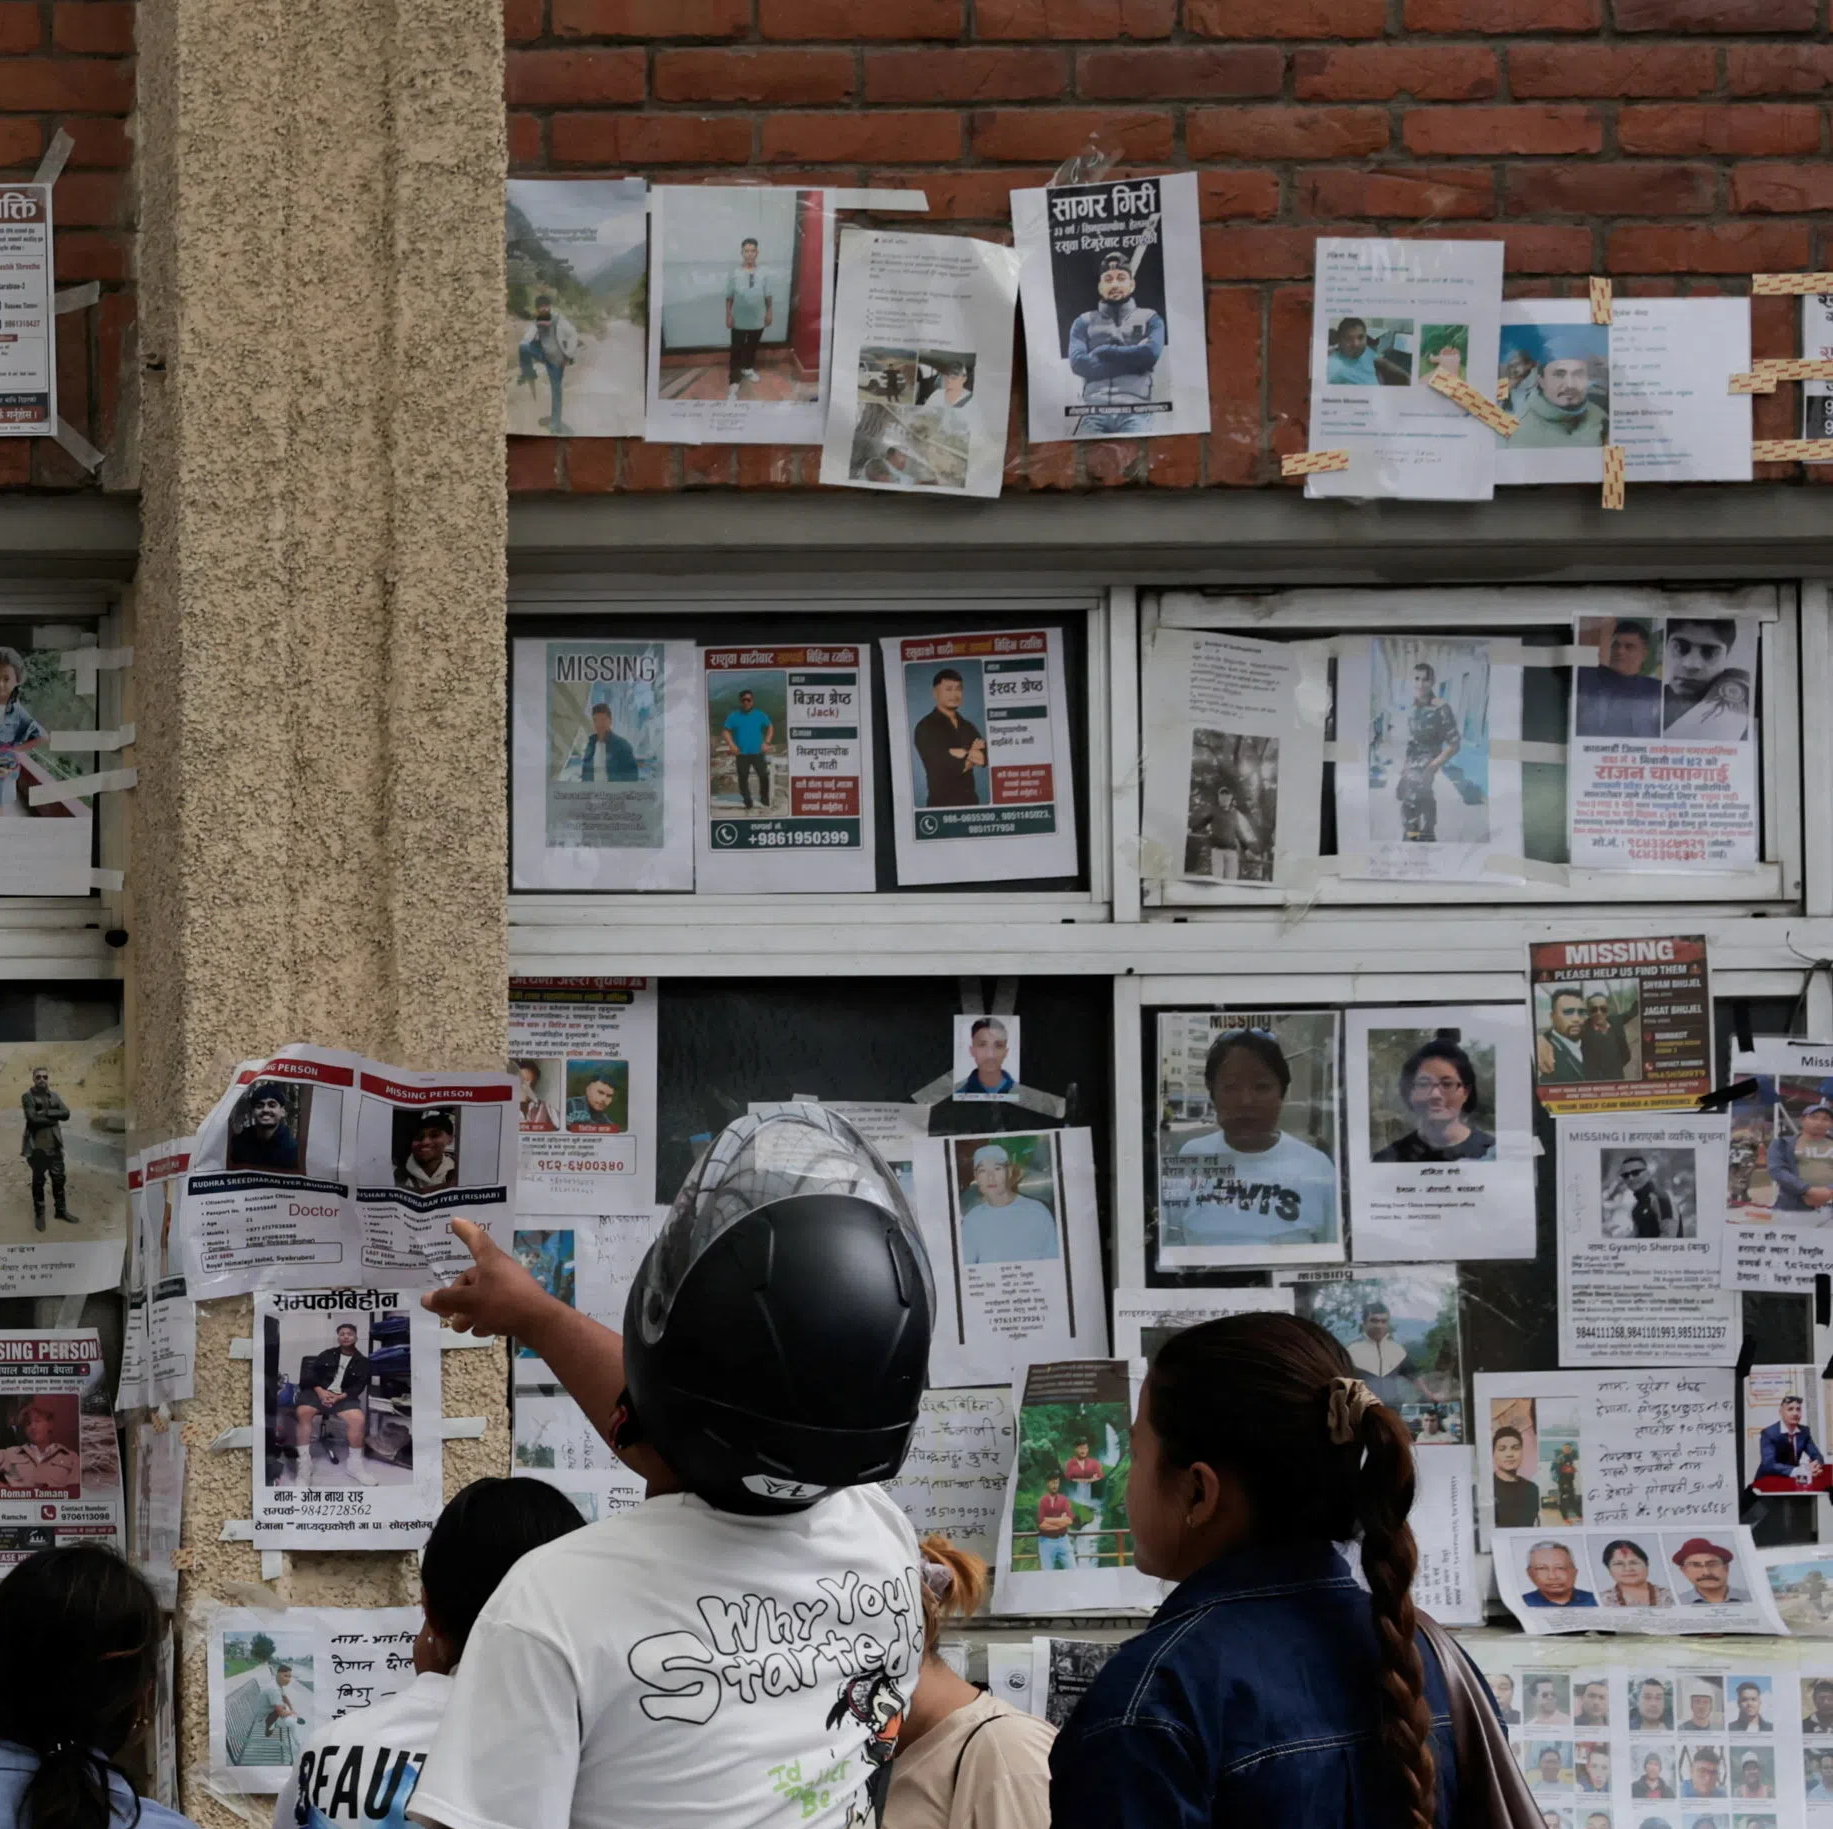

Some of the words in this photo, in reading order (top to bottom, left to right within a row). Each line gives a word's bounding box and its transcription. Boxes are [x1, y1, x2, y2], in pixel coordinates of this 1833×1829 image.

[1052, 194, 1108, 221] सागर
[1112, 183, 1156, 217] गिरी
[557, 655, 655, 682] MISSING
[1565, 941, 1674, 964] MISSING
[1554, 970, 1592, 980] PLEASE
[1593, 969, 1618, 978] HELP
[1619, 969, 1633, 977] US
[1635, 967, 1658, 976] FIND
[1660, 966, 1687, 975] THEM
[385, 1085, 427, 1101] MISSING
[429, 1088, 473, 1098] PERSON
[289, 1203, 340, 1217] Doctor
[39, 1340, 97, 1359] PERSON
[0, 1488, 32, 1498] Roman
[34, 1488, 69, 1499] Tamang
